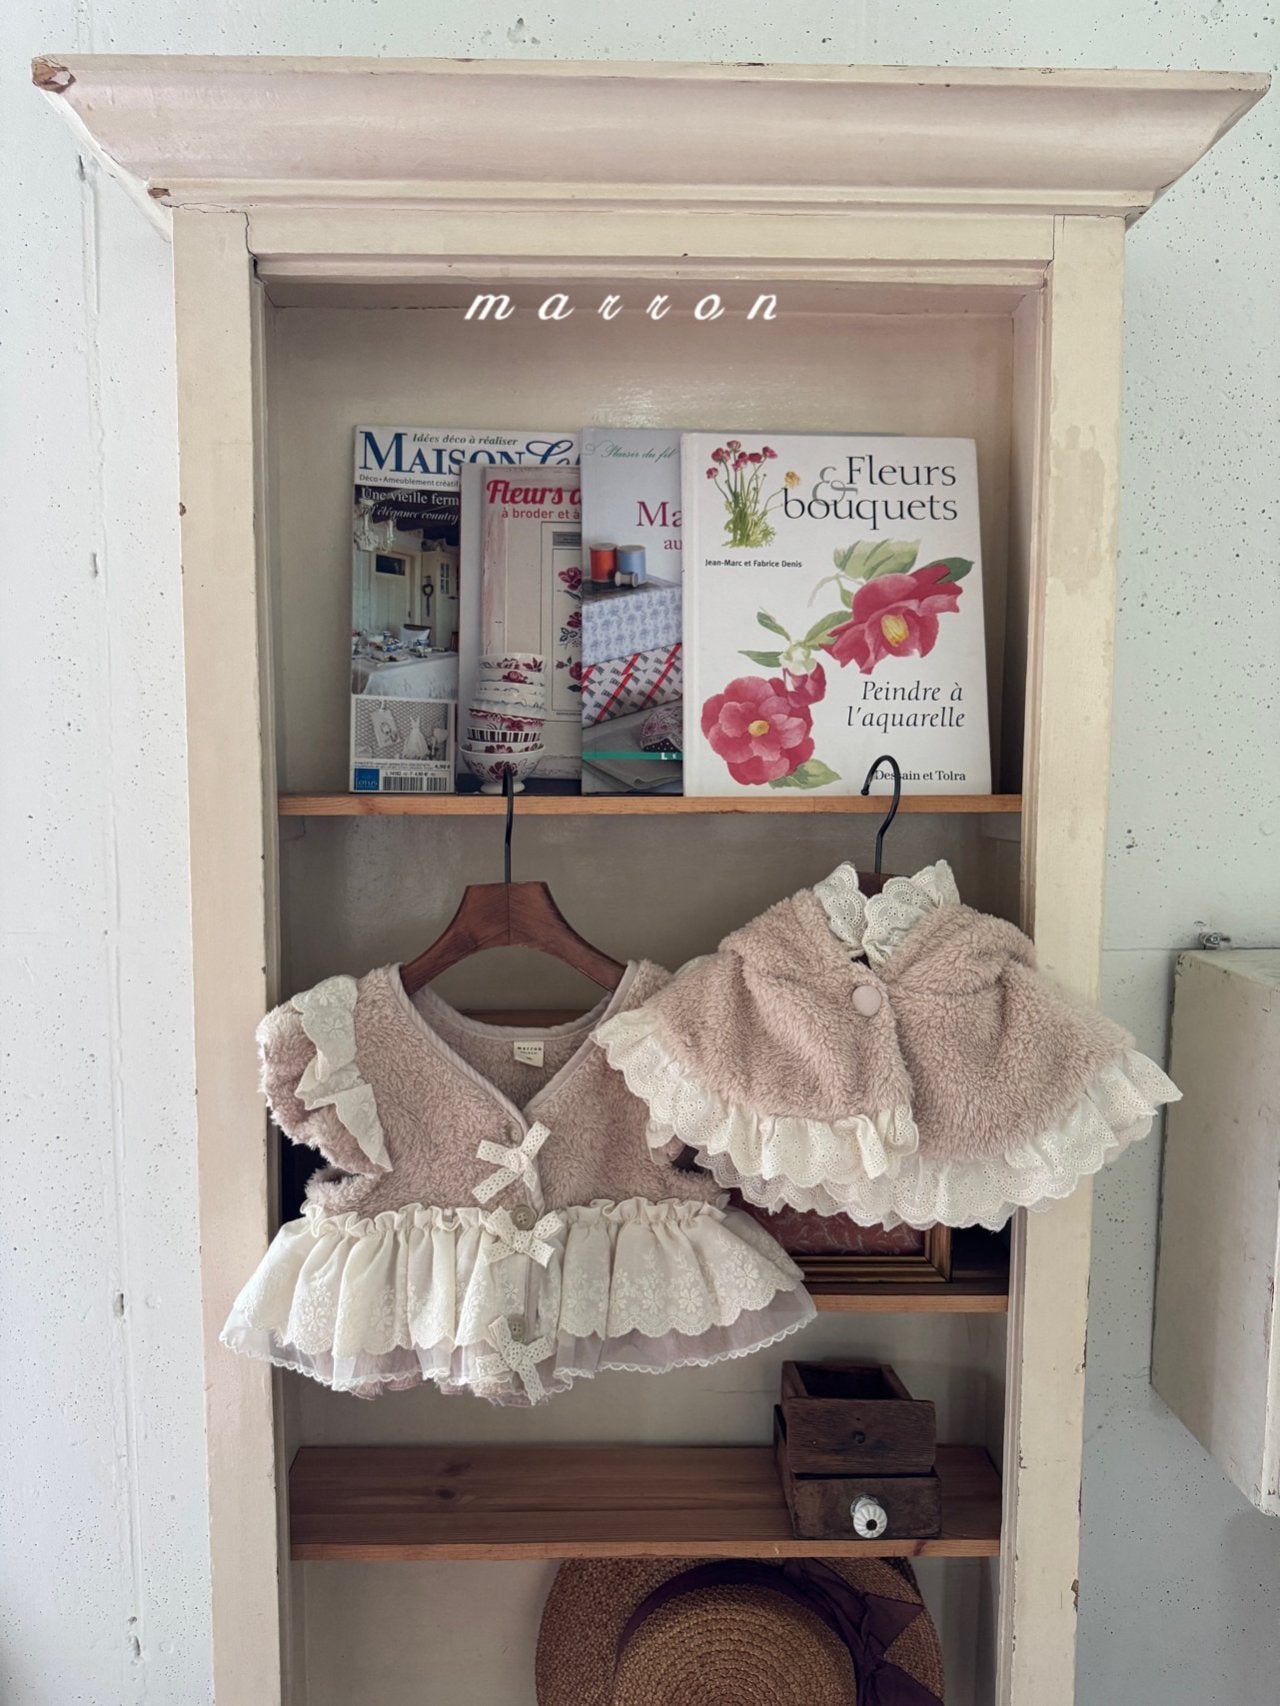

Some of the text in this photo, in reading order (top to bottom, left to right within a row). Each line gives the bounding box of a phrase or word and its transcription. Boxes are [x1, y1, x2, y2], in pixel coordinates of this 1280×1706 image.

[413, 433, 518, 446] Idées déco à réaliser
[846, 455, 957, 486] Fleurs
[361, 487, 387, 501] Une
[390, 491, 428, 504] vieille
[486, 480, 563, 505] Fleurs
[502, 507, 509, 519] à
[512, 508, 554, 519] broder
[557, 509, 571, 519] et
[783, 487, 958, 530] bouquets
[421, 512, 458, 525] country
[705, 558, 742, 567] Jean-Marc
[753, 560, 780, 568] Fabrice
[781, 560, 802, 568] Denis
[861, 680, 963, 701] Peindre à
[847, 706, 965, 734] l'aquarelle
[875, 770, 966, 781] Desain et Tolra
